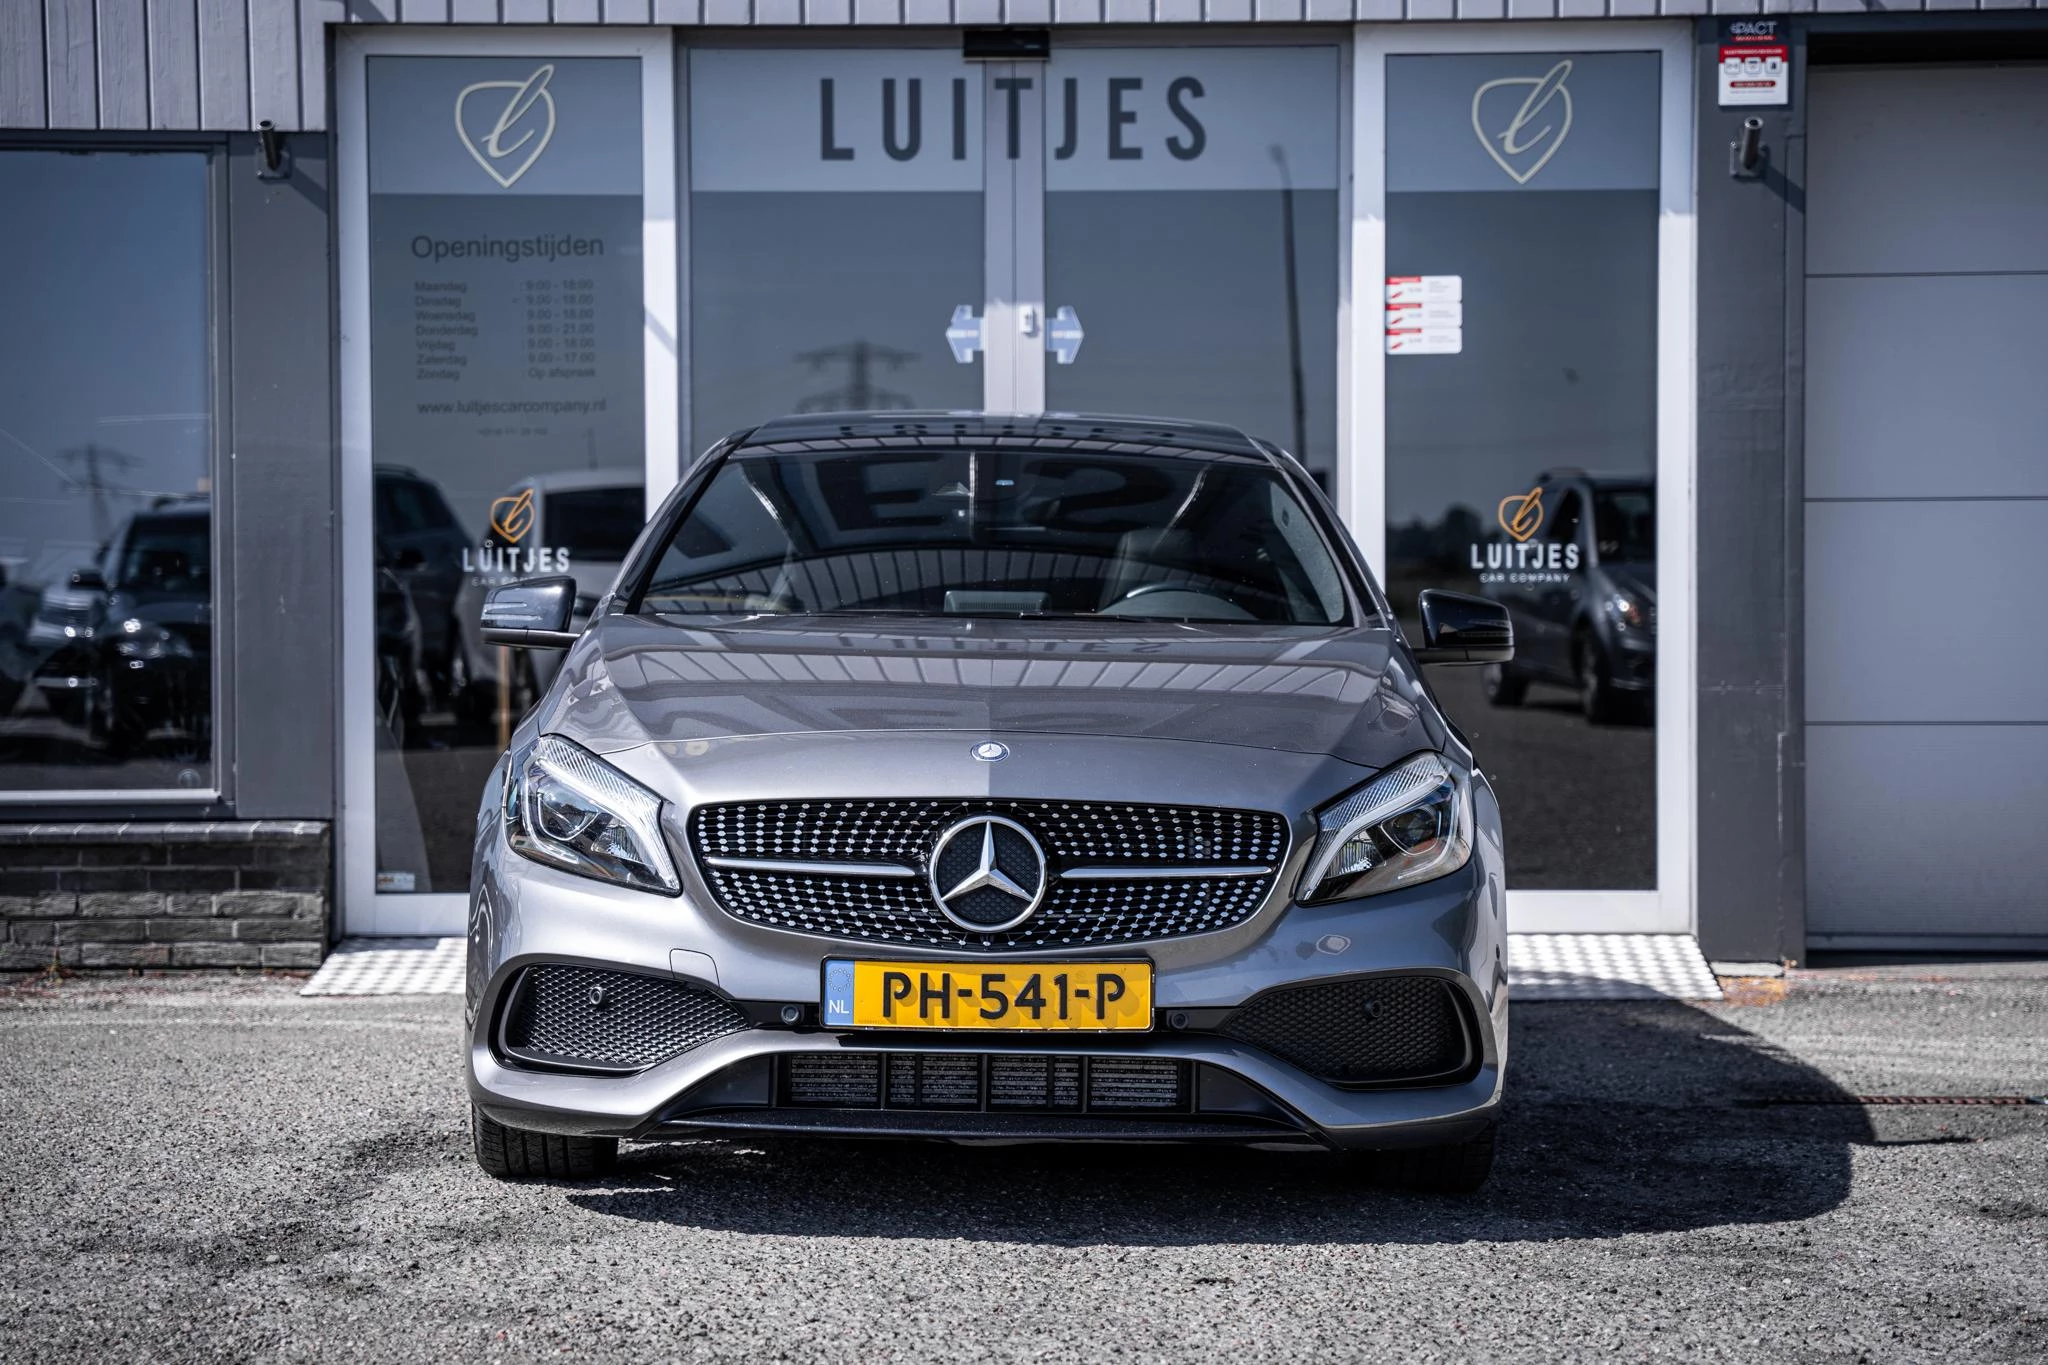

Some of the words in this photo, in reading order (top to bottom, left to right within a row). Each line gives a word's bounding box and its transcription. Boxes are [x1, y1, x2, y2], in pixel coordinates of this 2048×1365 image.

[820, 76, 1207, 161] LUITJES
[411, 234, 605, 263] Openingstijden
[462, 547, 570, 573] LUITJES
[1470, 543, 1580, 569] LUITJES
[1479, 572, 1505, 584] CAR
[1509, 572, 1571, 584] COMPANY
[828, 1000, 850, 1015] NL
[883, 971, 1126, 1020] PH-541-P
